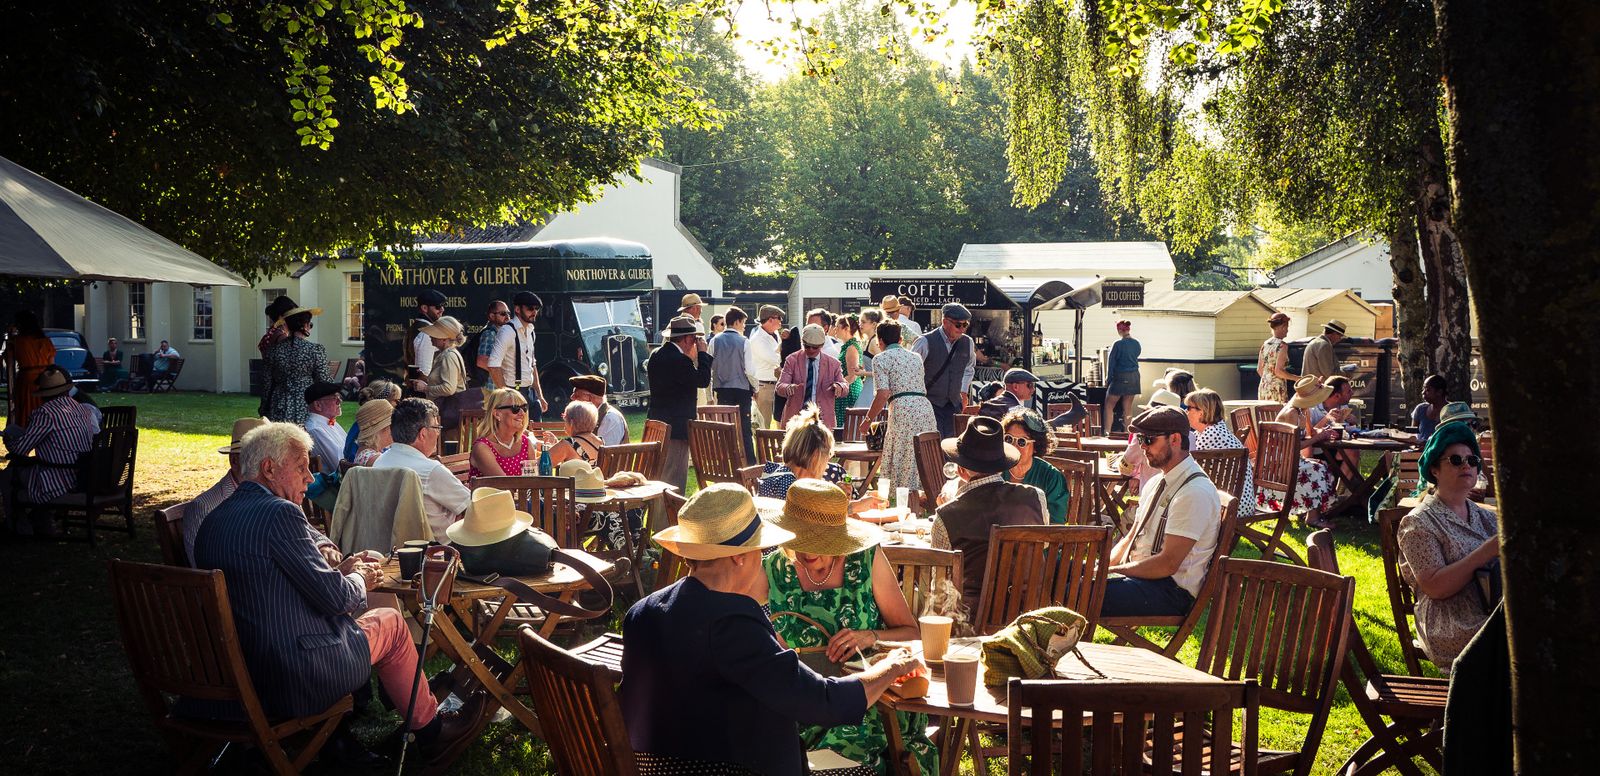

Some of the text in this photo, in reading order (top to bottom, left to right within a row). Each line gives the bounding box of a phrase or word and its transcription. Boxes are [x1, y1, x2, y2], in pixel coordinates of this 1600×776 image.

[380, 266, 531, 285] NORTHOVER & GILBERT
[566, 268, 620, 281] NORTHOVER
[620, 270, 626, 280] &
[844, 281, 870, 291] THRO
[897, 283, 955, 297] COFFEE
[1105, 290, 1141, 301] ICED COFFEES
[400, 296, 467, 308] HOUS SHERS
